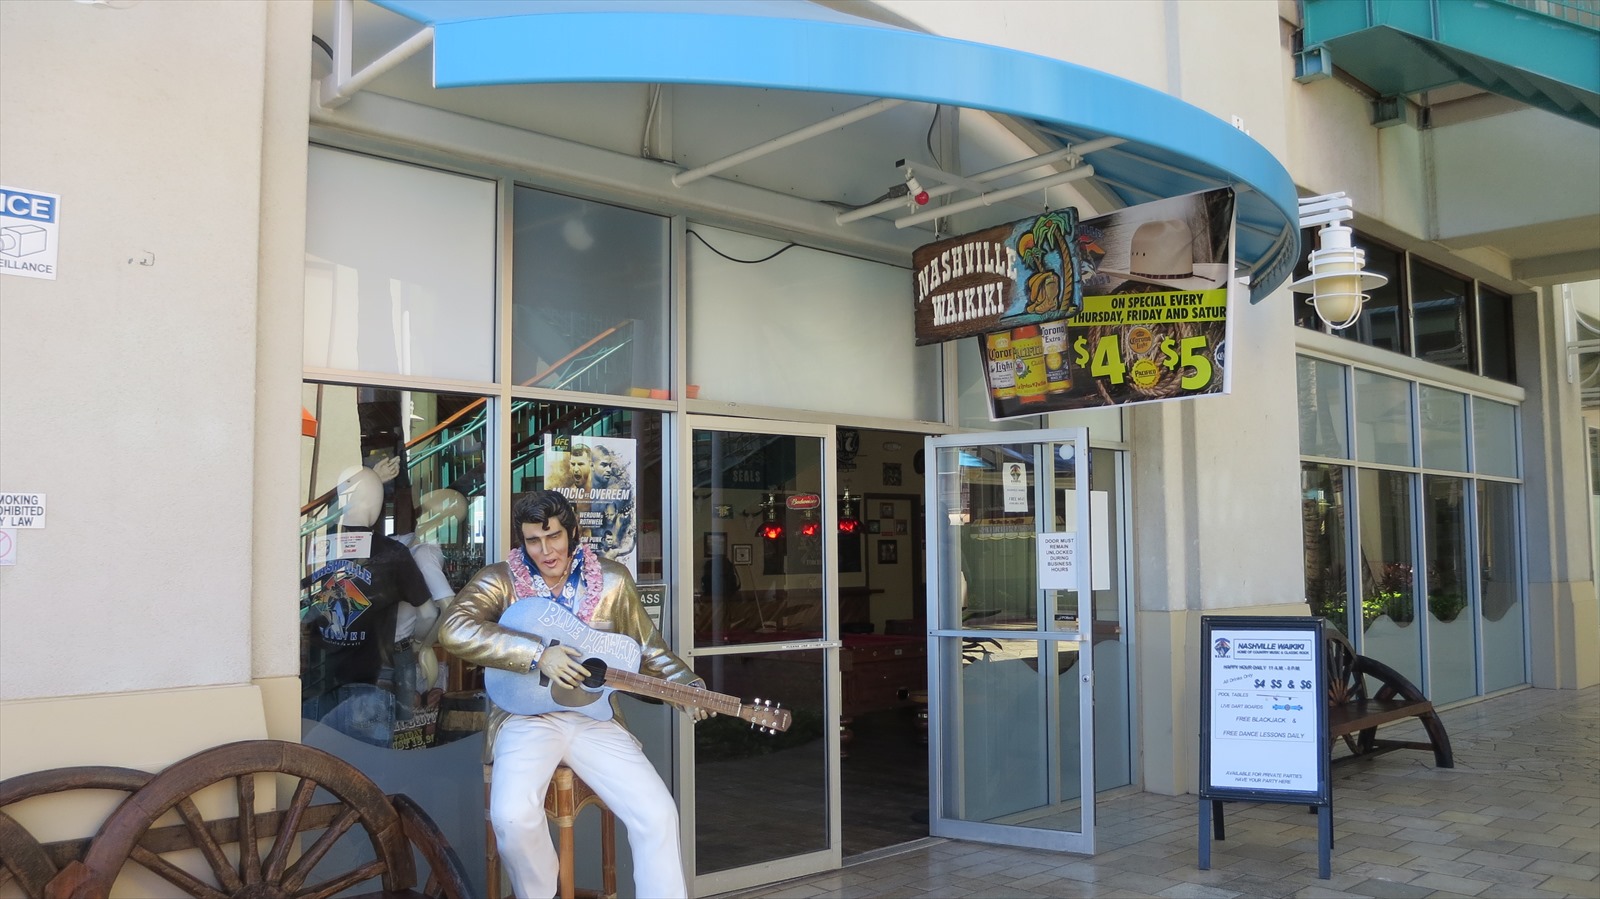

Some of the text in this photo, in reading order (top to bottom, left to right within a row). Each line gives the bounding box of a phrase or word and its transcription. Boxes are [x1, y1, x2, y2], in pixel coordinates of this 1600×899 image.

[918, 241, 1017, 303] NASHVILLE
[931, 281, 1005, 327] WAIKIKI
[1111, 293, 1204, 309] ON SPECIAL EVERY
[1126, 308, 1163, 321] FRIDAY
[1165, 307, 1189, 319] AND
[1073, 334, 1126, 385] $4
[1160, 335, 1213, 390] $5
[554, 438, 570, 446] UFC
[733, 470, 761, 482] SEALS
[590, 488, 631, 500] OVEREEM
[11, 517, 34, 526] LAW
[537, 601, 587, 640] BLUE
[580, 628, 641, 668] HAWAII
[1237, 642, 1276, 650] NASHVILLE
[1254, 679, 1313, 690] $4 $5 & $6
